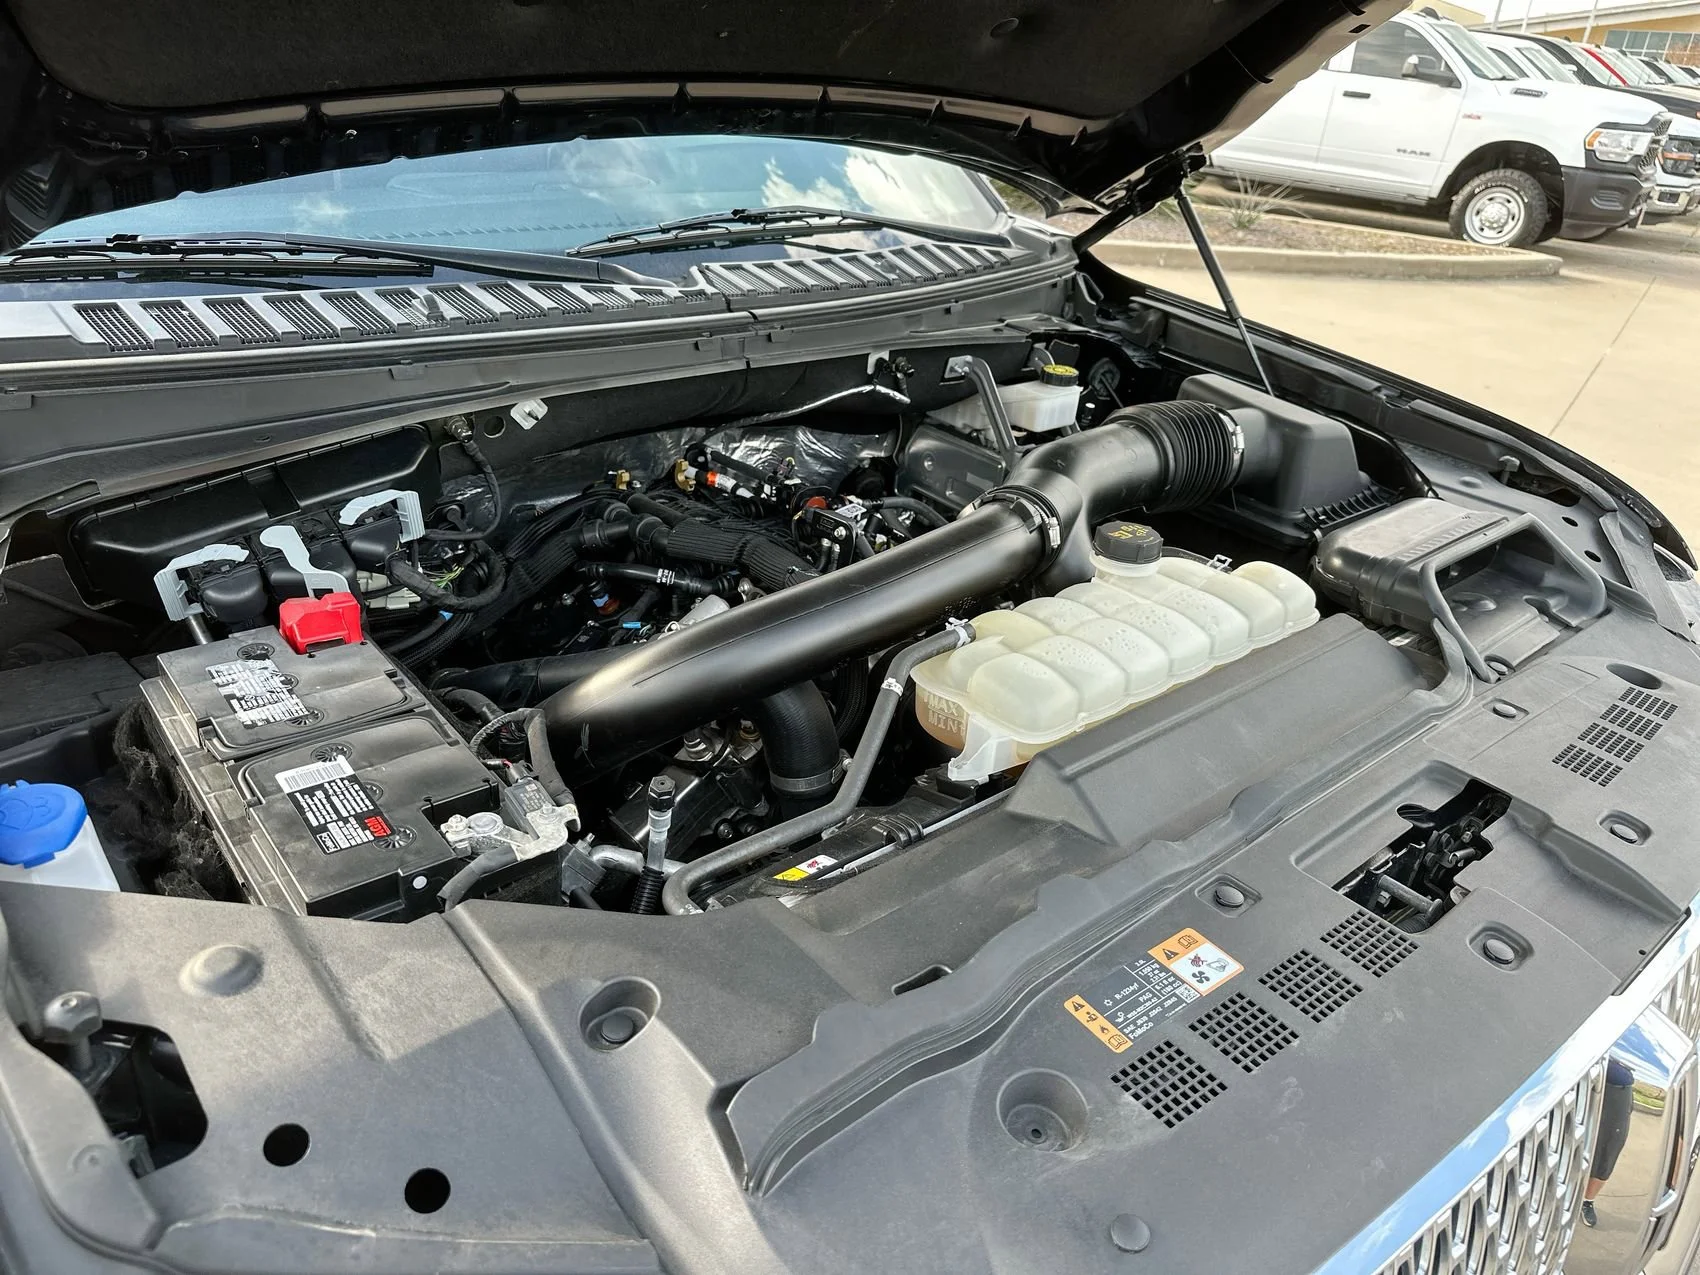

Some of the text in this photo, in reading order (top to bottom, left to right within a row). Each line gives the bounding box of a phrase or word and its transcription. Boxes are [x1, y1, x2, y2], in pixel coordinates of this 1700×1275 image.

[928, 693, 958, 716] MAX
[928, 710, 958, 733] MIN
[364, 816, 388, 837] AGM
[1114, 982, 1140, 1001] R-1234yf
[1138, 992, 1153, 1003] PAG
[1123, 1024, 1136, 1034] SAE
[1128, 1021, 1155, 1040] FoMoCo
